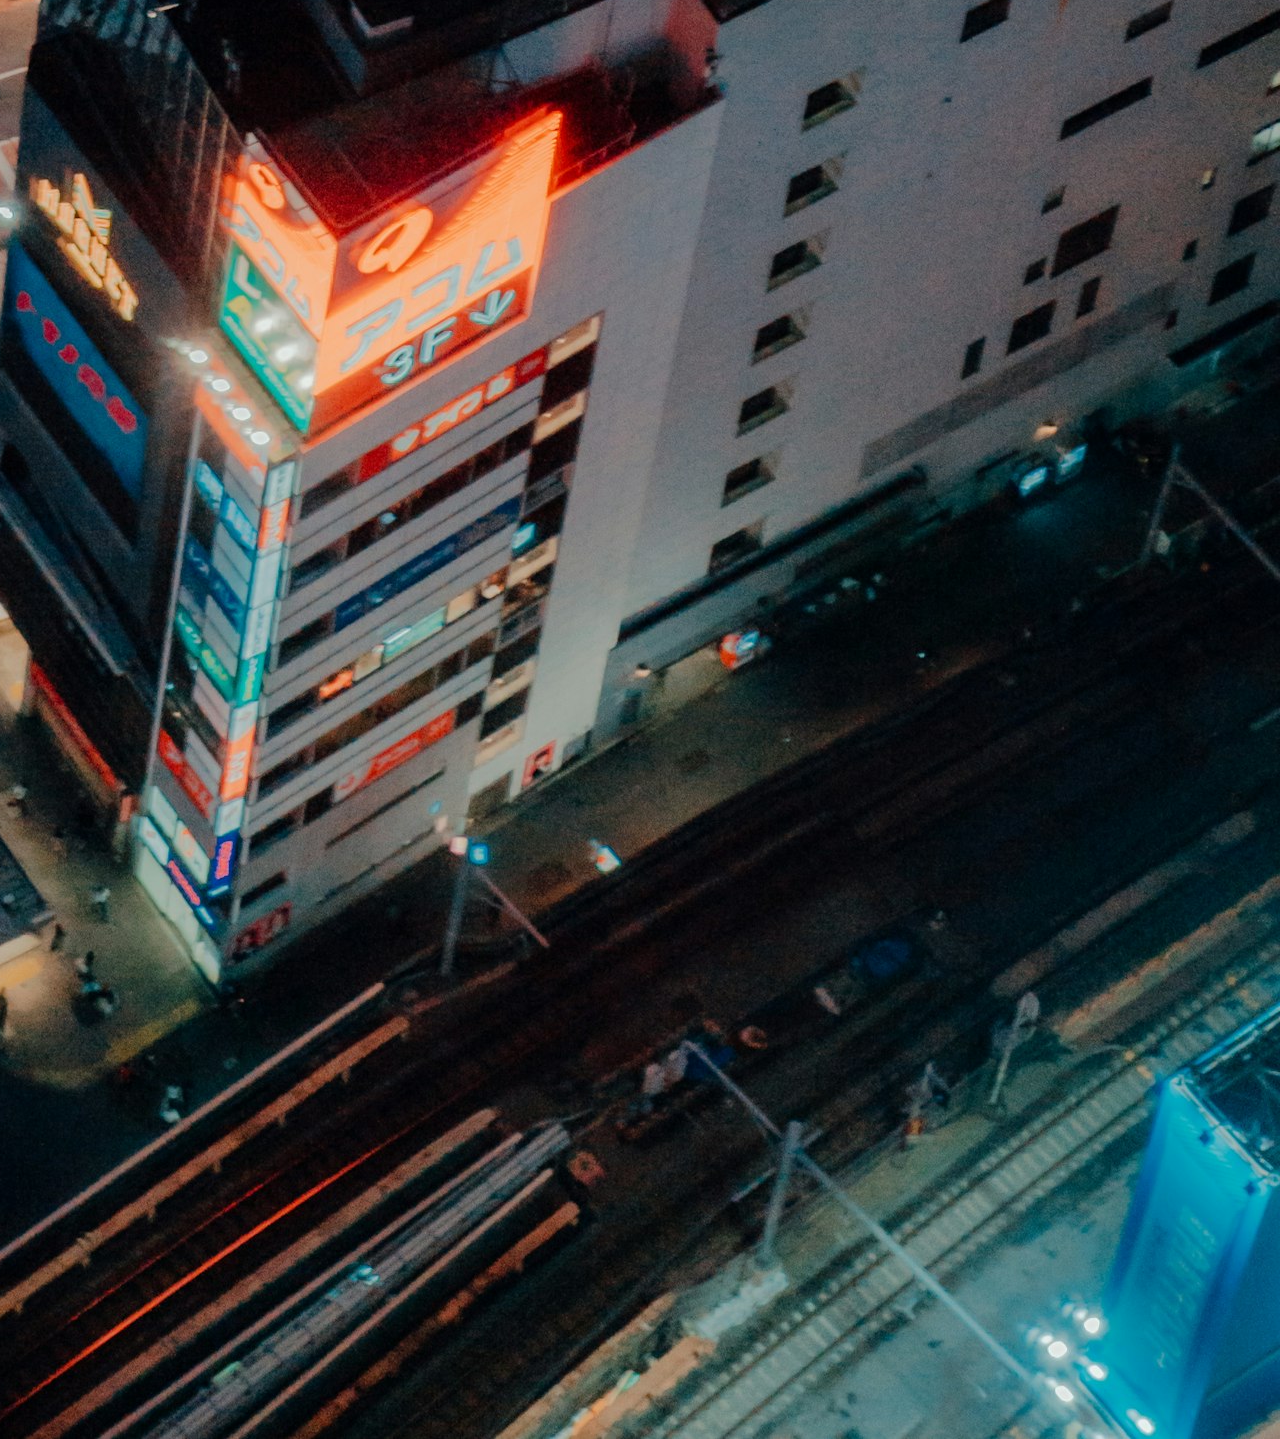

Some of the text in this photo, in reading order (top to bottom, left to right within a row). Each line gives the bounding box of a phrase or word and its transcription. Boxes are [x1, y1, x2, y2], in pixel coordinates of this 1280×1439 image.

[339, 234, 524, 374] アコム
[380, 316, 458, 386] 3F
